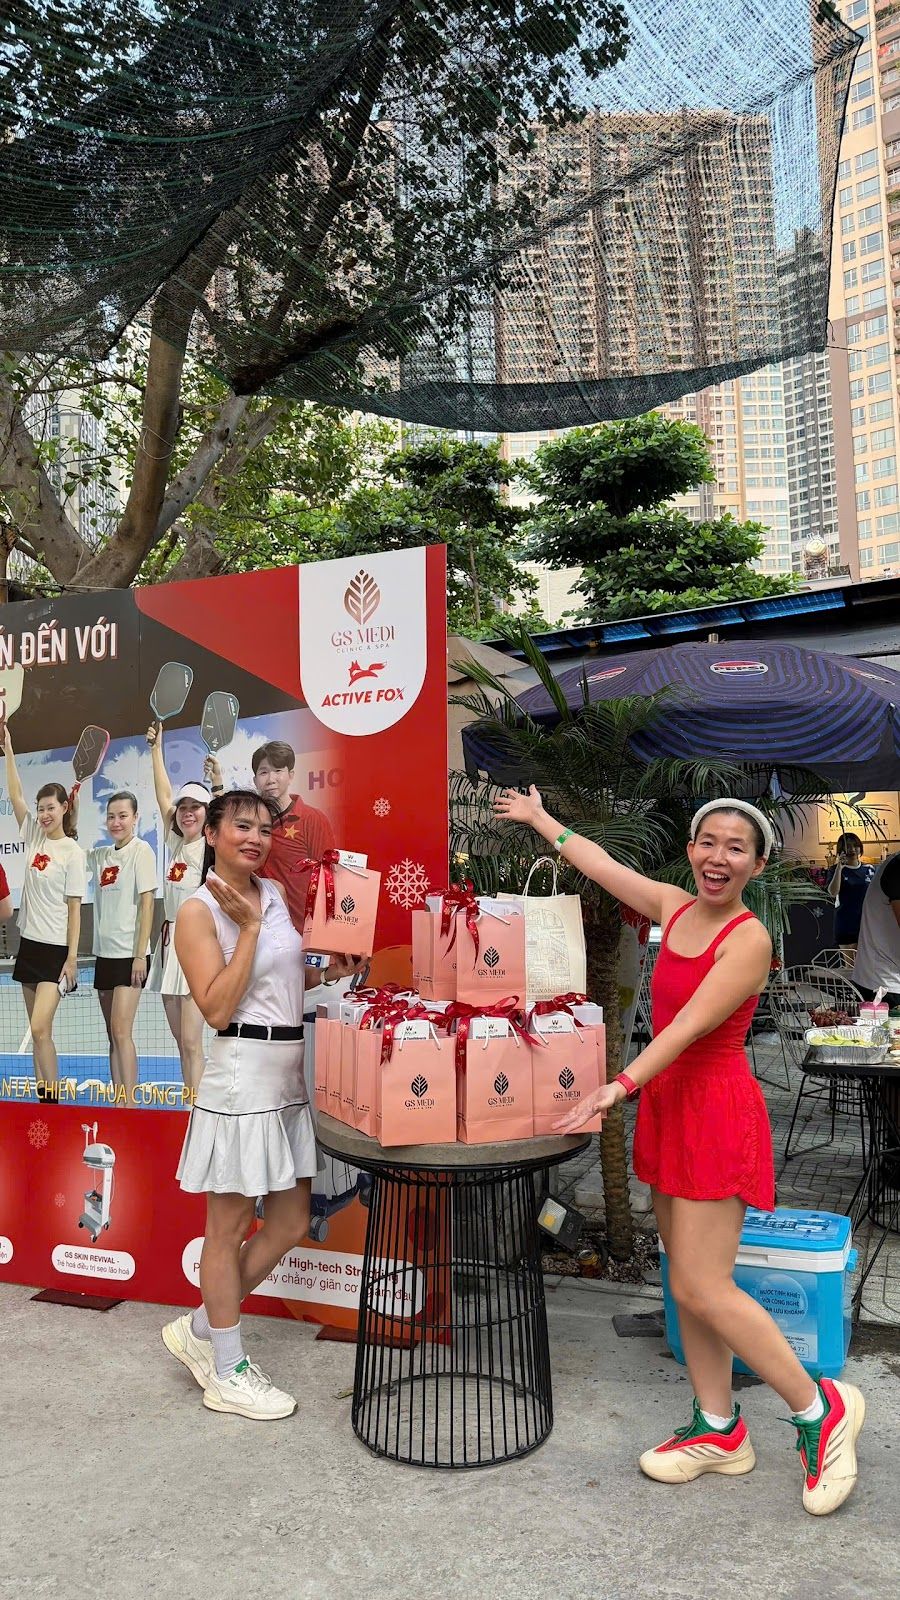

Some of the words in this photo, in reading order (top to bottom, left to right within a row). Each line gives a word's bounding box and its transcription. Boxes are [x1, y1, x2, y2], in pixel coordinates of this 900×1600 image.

[20, 619, 67, 667] ĐẾN
[75, 616, 117, 662] VỚI
[331, 629, 353, 647] GS
[357, 625, 396, 644] MEDI
[336, 646, 363, 654] CLINIC
[321, 690, 373, 707] ACTIVE
[376, 687, 406, 703] FOX
[15, 1076, 32, 1098] LÀ
[35, 1076, 77, 1101] CHIẾN
[131, 1082, 176, 1106] CŨNG
[404, 1099, 415, 1108] GS
[417, 1098, 435, 1107] MEDI
[64, 1251, 73, 1259] GS
[74, 1252, 88, 1260] SKIN
[89, 1255, 115, 1264] REVIVAL
[289, 1256, 342, 1274] High-tech
[319, 1278, 342, 1291] giãn
[344, 1283, 359, 1293] cơ
